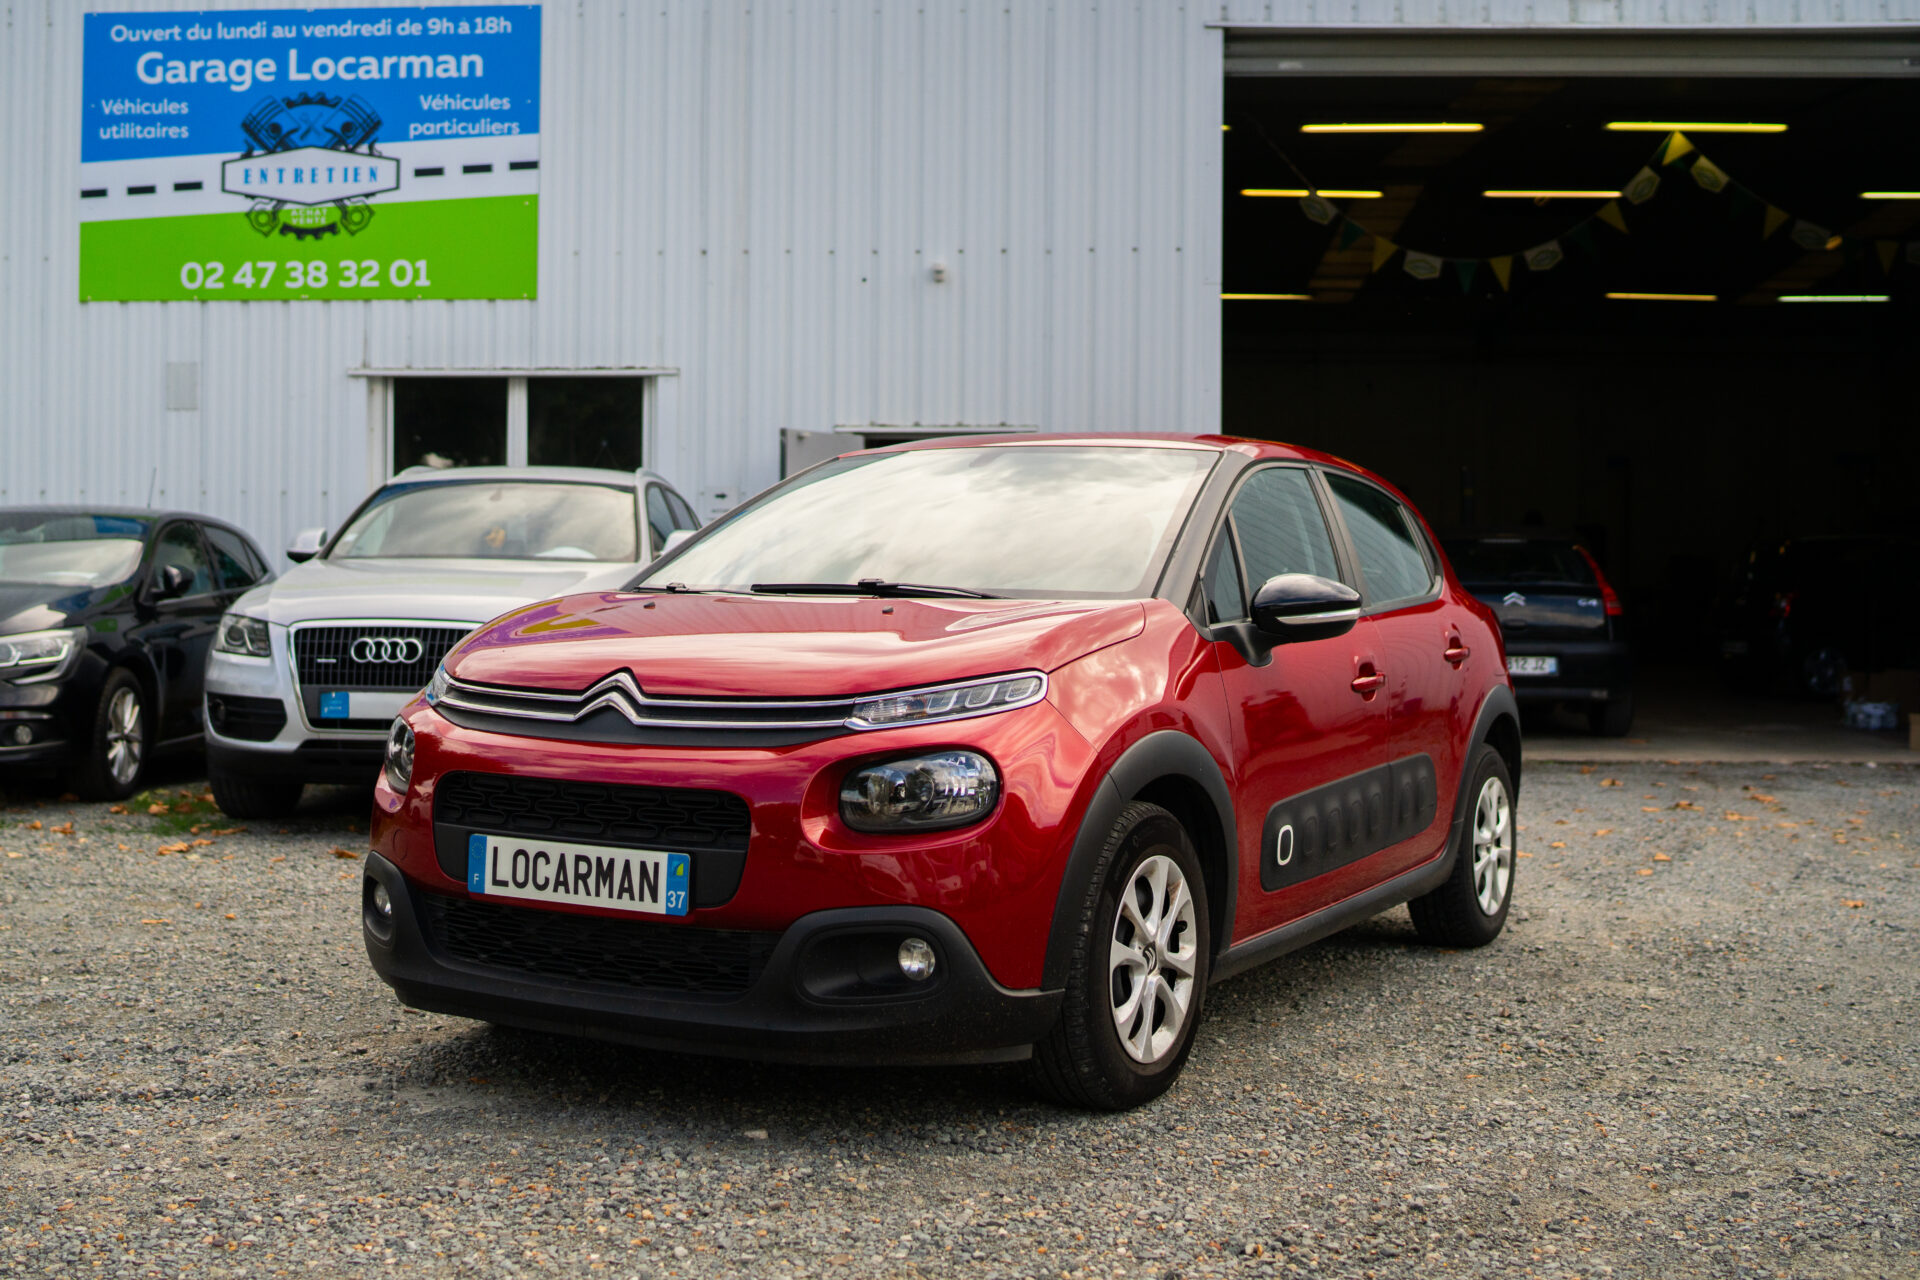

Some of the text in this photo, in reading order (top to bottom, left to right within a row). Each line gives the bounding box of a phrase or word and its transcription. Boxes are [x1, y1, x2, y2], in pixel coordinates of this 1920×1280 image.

[110, 16, 512, 42] Ouvert du lundi au vendredi de 9h à 18h
[136, 49, 484, 92] Garage Locarman
[101, 98, 189, 116] Véhicules
[419, 94, 511, 112] Véhicules
[100, 121, 189, 140] utilitaires
[408, 118, 520, 140] particuliers
[243, 166, 379, 184] ENTRETIEN
[291, 216, 327, 225] VENTE
[180, 259, 431, 290] 02 47 38 32 01
[473, 846, 686, 909] F LOCARMAN 37
